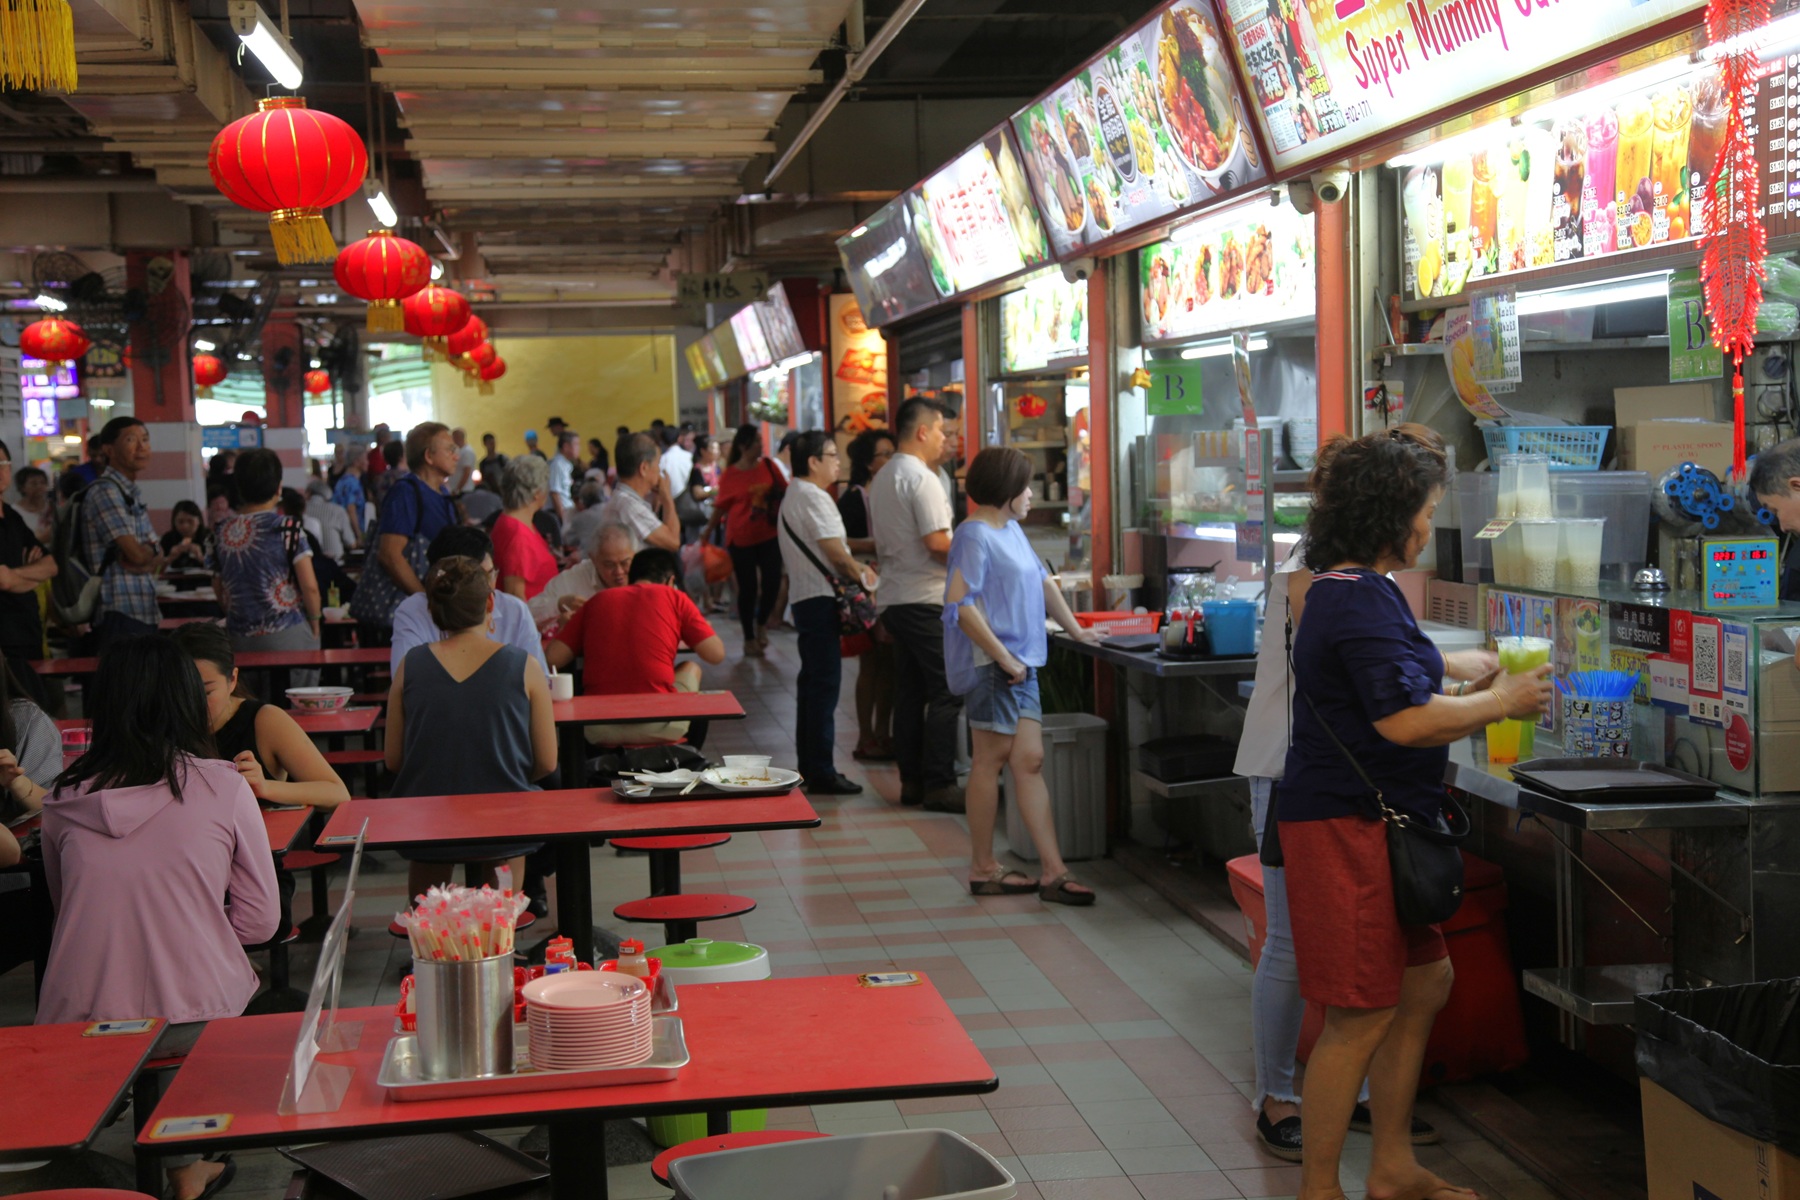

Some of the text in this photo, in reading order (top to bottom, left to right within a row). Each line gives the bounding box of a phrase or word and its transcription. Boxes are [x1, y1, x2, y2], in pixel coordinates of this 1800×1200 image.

[1345, 29, 1410, 98] Super
[1406, 0, 1509, 61] Mummy
[1345, 100, 1373, 123] #02-171
[1616, 204, 1631, 216] $2.00
[1653, 197, 1668, 207] $2.00
[1445, 322, 1468, 345] Special
[1683, 299, 1705, 351] B
[1165, 374, 1185, 401] B
[1696, 441, 1723, 449] SPOON
[1616, 626, 1633, 641] SELF
[1633, 628, 1661, 646] SERVICE
